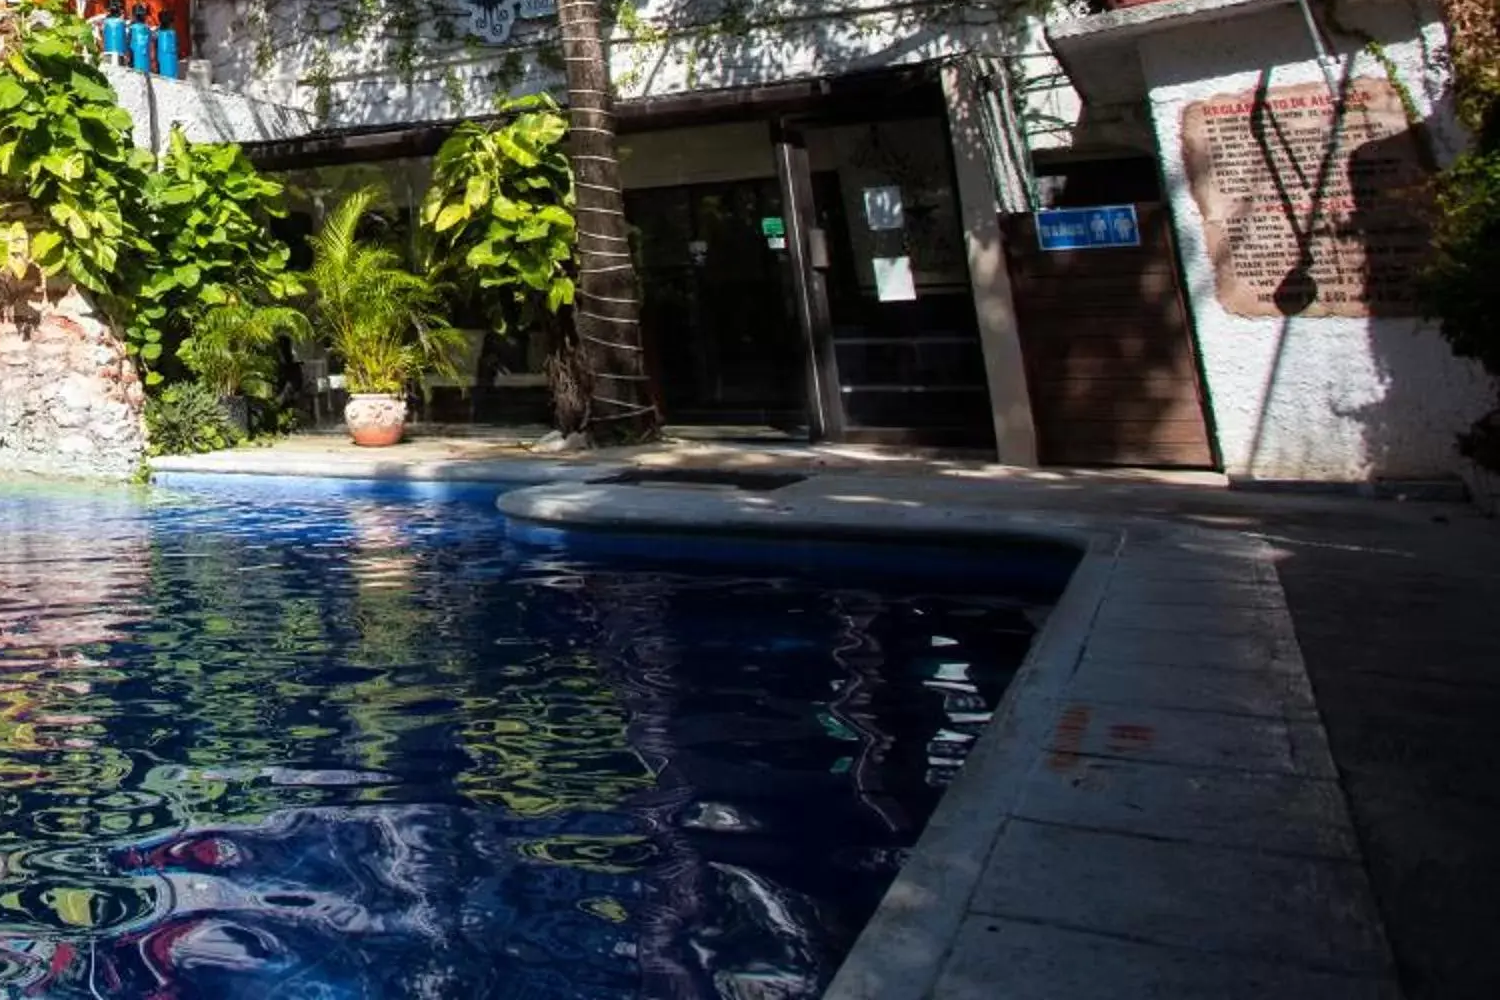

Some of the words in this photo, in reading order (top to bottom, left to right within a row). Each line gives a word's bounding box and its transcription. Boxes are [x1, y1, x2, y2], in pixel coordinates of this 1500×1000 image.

[1203, 97, 1286, 116] REGLAMTO
[1289, 95, 1306, 107] DE
[1311, 90, 1371, 107] ALBCA
